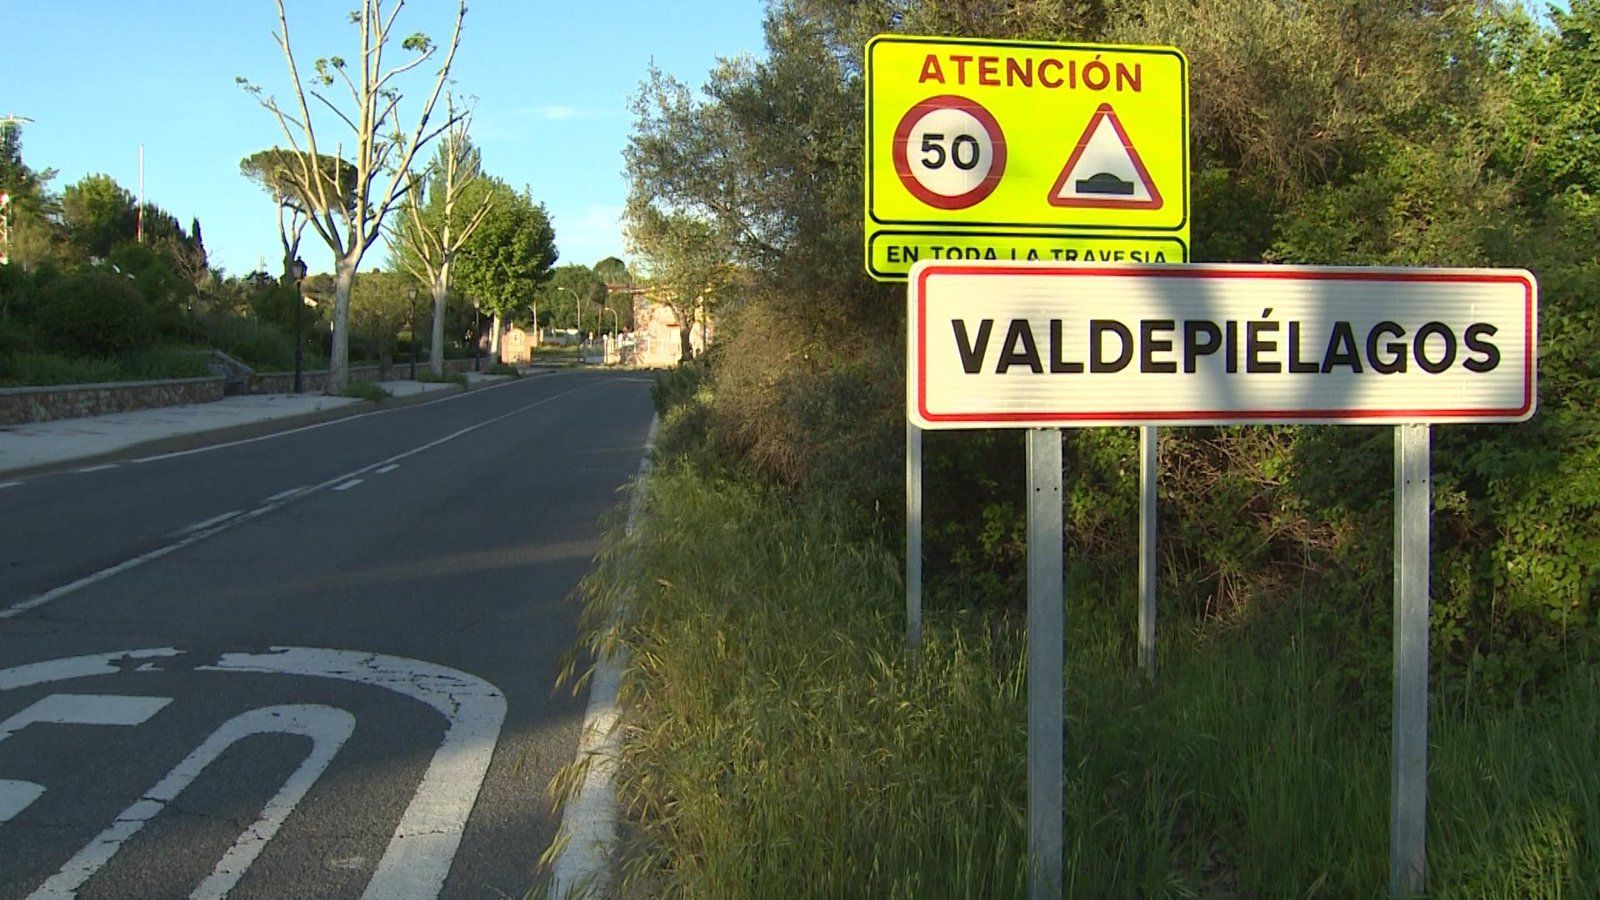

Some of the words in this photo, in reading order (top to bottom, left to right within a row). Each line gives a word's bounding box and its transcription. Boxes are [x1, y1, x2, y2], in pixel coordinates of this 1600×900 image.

[919, 54, 1142, 92] ATENCIÓN
[921, 133, 980, 170] 50
[887, 245, 919, 263] EN
[930, 246, 997, 260] TODA
[951, 307, 1501, 375] VALDEPIÉLAGOS
